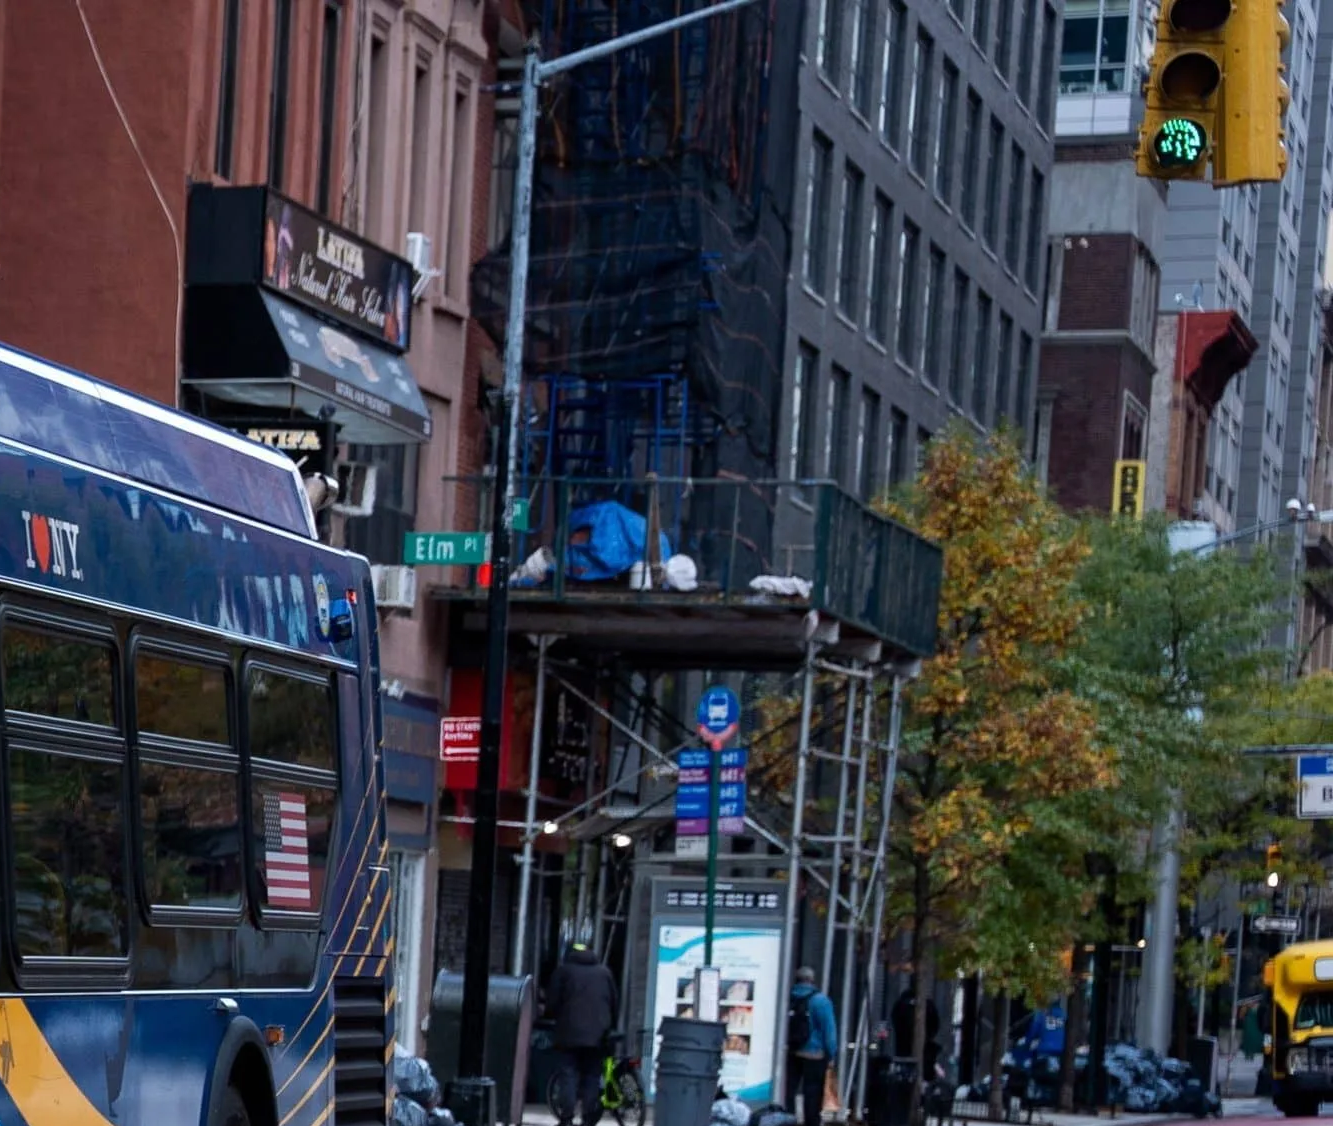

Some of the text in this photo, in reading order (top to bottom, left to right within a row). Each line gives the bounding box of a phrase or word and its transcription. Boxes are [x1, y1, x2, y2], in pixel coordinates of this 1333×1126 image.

[290, 252, 386, 328] Natural Hair Salon
[415, 535, 477, 561] Elm Pl
